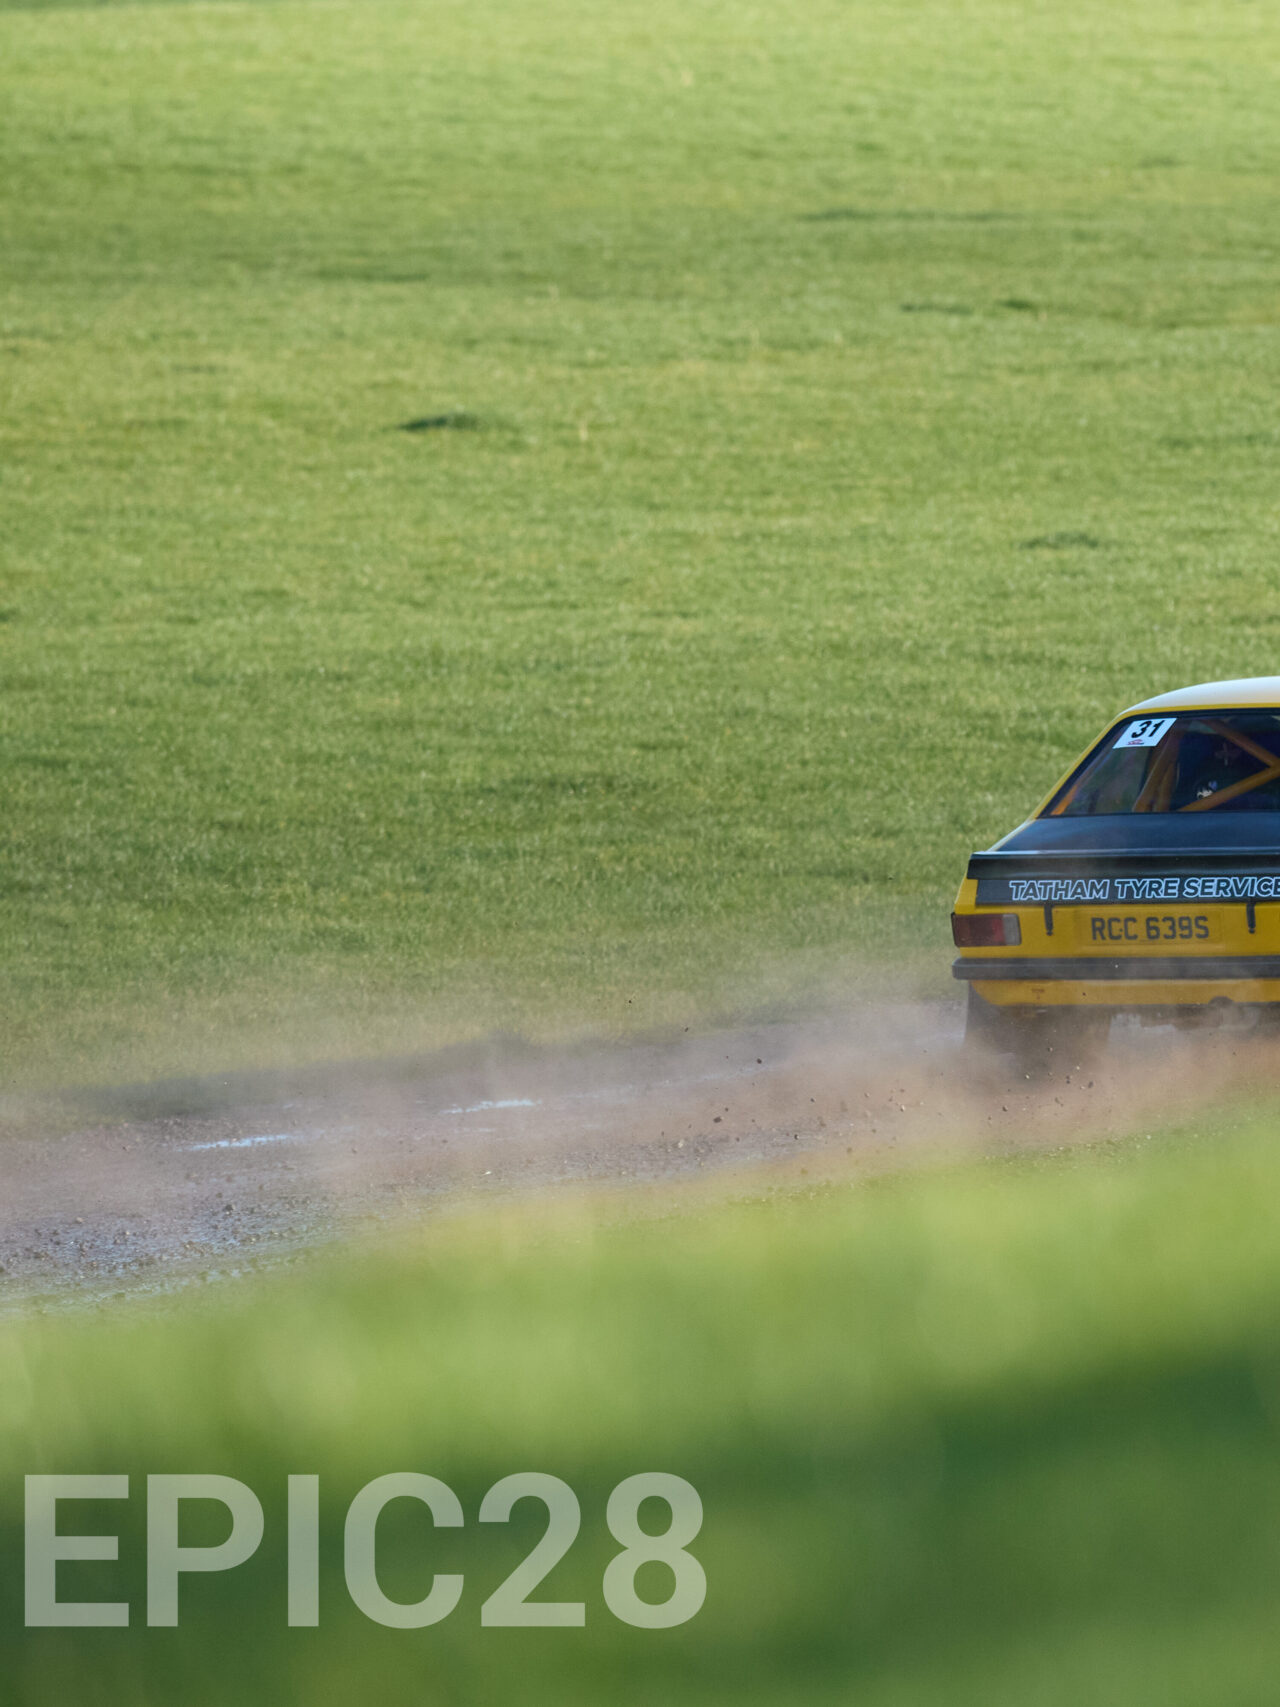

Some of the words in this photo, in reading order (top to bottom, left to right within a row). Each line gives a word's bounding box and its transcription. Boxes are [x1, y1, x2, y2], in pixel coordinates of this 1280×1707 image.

[1131, 720, 1165, 738] 31
[1009, 879, 1110, 901] TATHAM
[1114, 878, 1180, 898] TYRE
[1091, 917, 1138, 941] RCC
[1145, 915, 1209, 940] 639S
